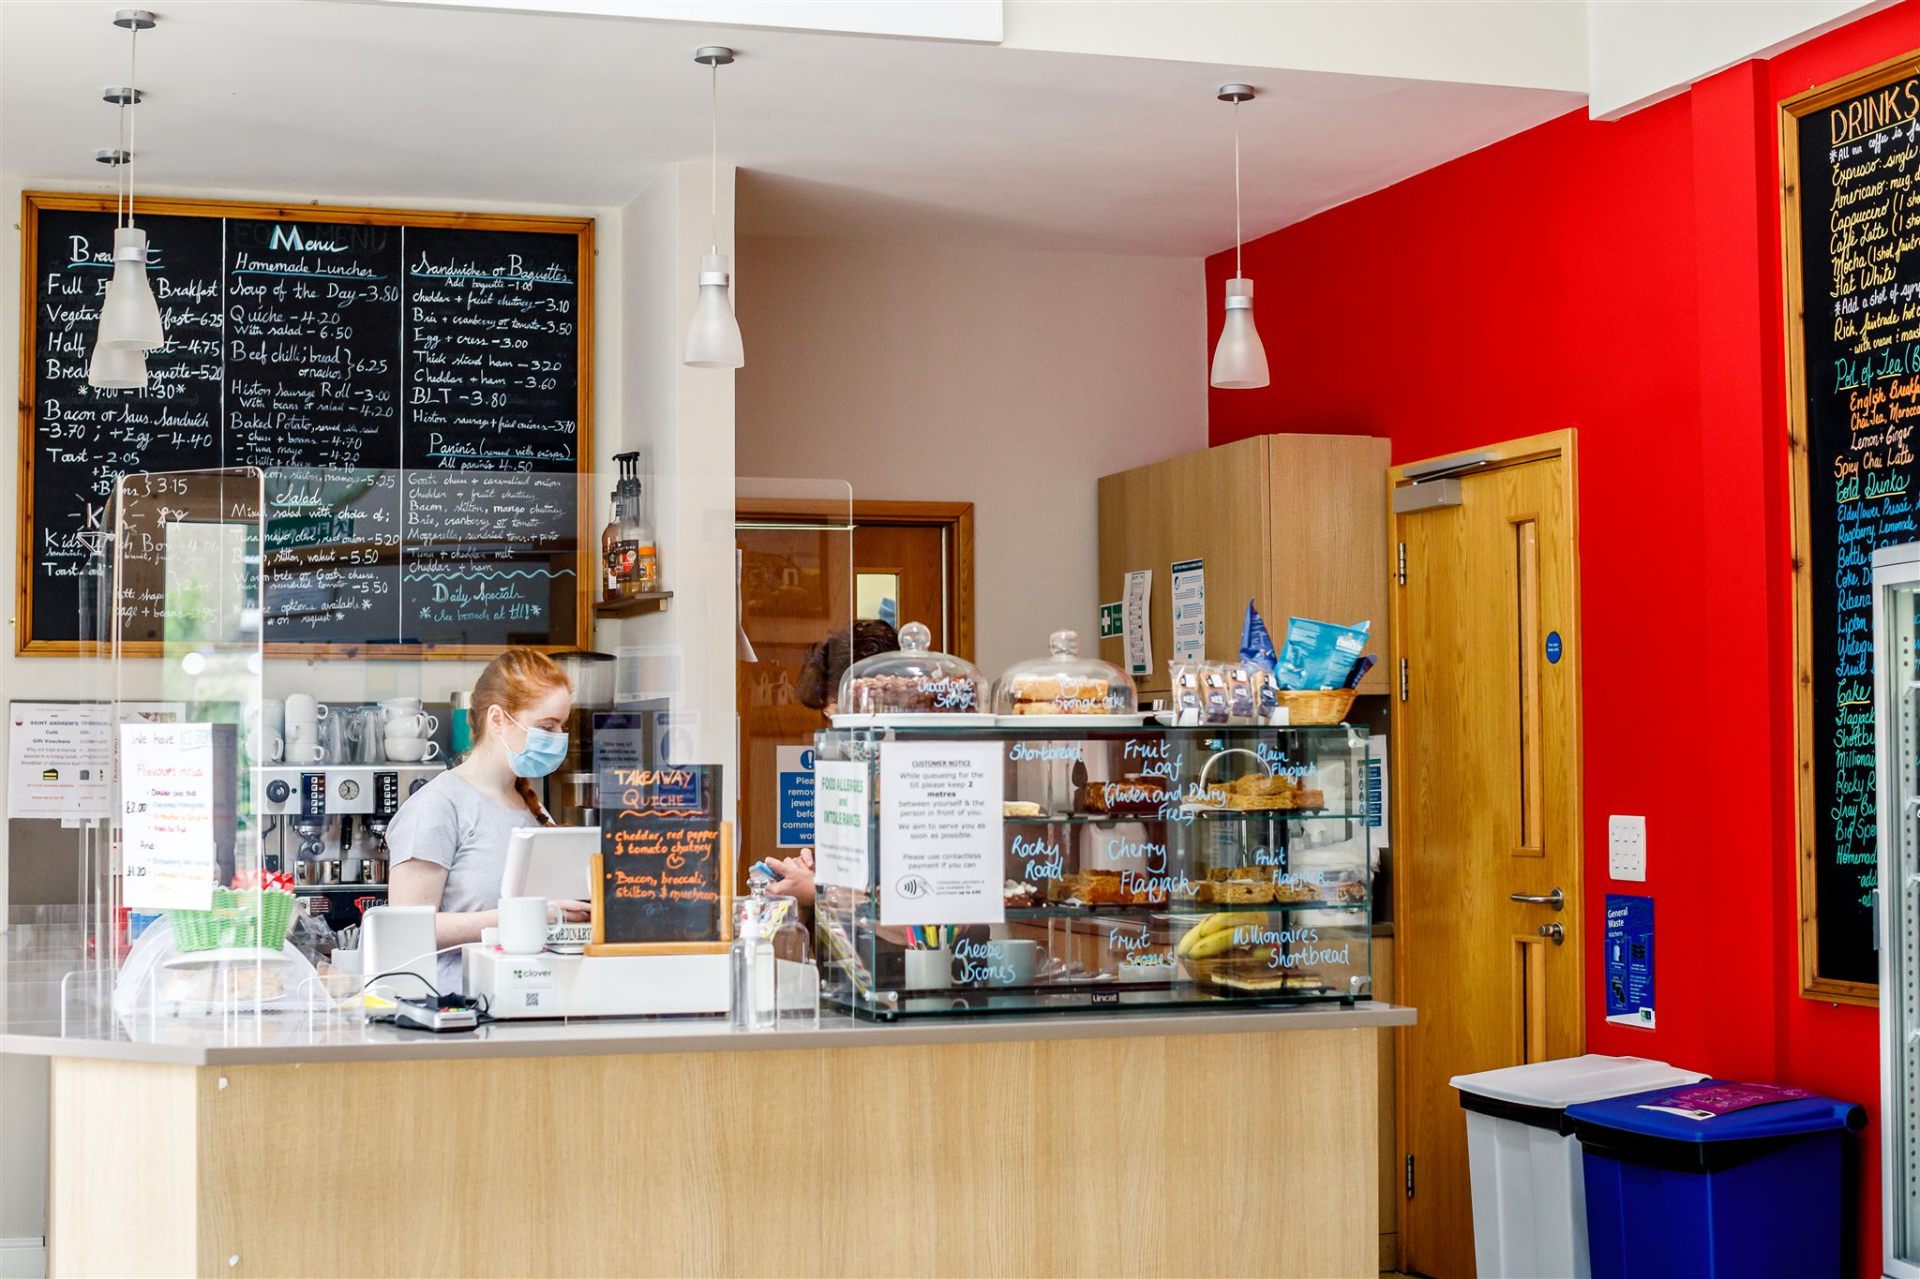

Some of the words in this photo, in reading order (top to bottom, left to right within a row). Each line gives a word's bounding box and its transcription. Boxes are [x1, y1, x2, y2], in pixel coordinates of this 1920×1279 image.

[1831, 80, 1920, 145] DRINKS
[269, 225, 348, 252] Menu
[236, 252, 311, 272] Homemade
[315, 258, 376, 277] Lunches
[411, 251, 489, 276] Sandwiches
[493, 267, 506, 276] or
[508, 254, 571, 282] Baguettes
[48, 274, 82, 294] Full
[1861, 263, 1896, 289] White
[230, 276, 266, 303] Soup
[273, 279, 287, 302] of
[293, 281, 319, 299] the
[230, 305, 286, 323] Quiche
[267, 325, 303, 335] salad
[413, 327, 441, 349] Egg
[457, 335, 489, 346] cress
[48, 332, 86, 358] Half
[231, 340, 267, 365] Beef
[413, 350, 446, 363] Thick
[489, 354, 512, 367] ham
[481, 370, 506, 384] ham
[321, 382, 351, 399] Roll
[410, 387, 452, 404] BLT
[43, 399, 96, 421] Bacon
[101, 410, 117, 421] or
[230, 411, 272, 429] Baked
[430, 433, 477, 453] Paninis
[46, 448, 88, 463] Toast
[439, 457, 455, 469] All
[432, 582, 471, 608] Daily
[473, 581, 525, 605] Specials
[1009, 741, 1083, 762] Shortbread
[1124, 739, 1171, 760] Fruit
[1257, 743, 1289, 763] Plain
[1142, 754, 1183, 781] Loaf
[614, 770, 693, 787] TAKEAWAY
[796, 777, 814, 785] Plea
[623, 788, 686, 809] QUICHE
[1153, 784, 1182, 803] and
[1011, 835, 1060, 867] Rocky
[1108, 839, 1168, 873] Cherry
[1255, 847, 1287, 865] Fruit
[1025, 858, 1063, 881] Road
[1120, 869, 1200, 903] Flapjack
[1109, 925, 1151, 950] Fruit
[1233, 927, 1319, 946] Millionaires
[1268, 944, 1350, 969] Shortbread
[523, 968, 552, 978] clover
